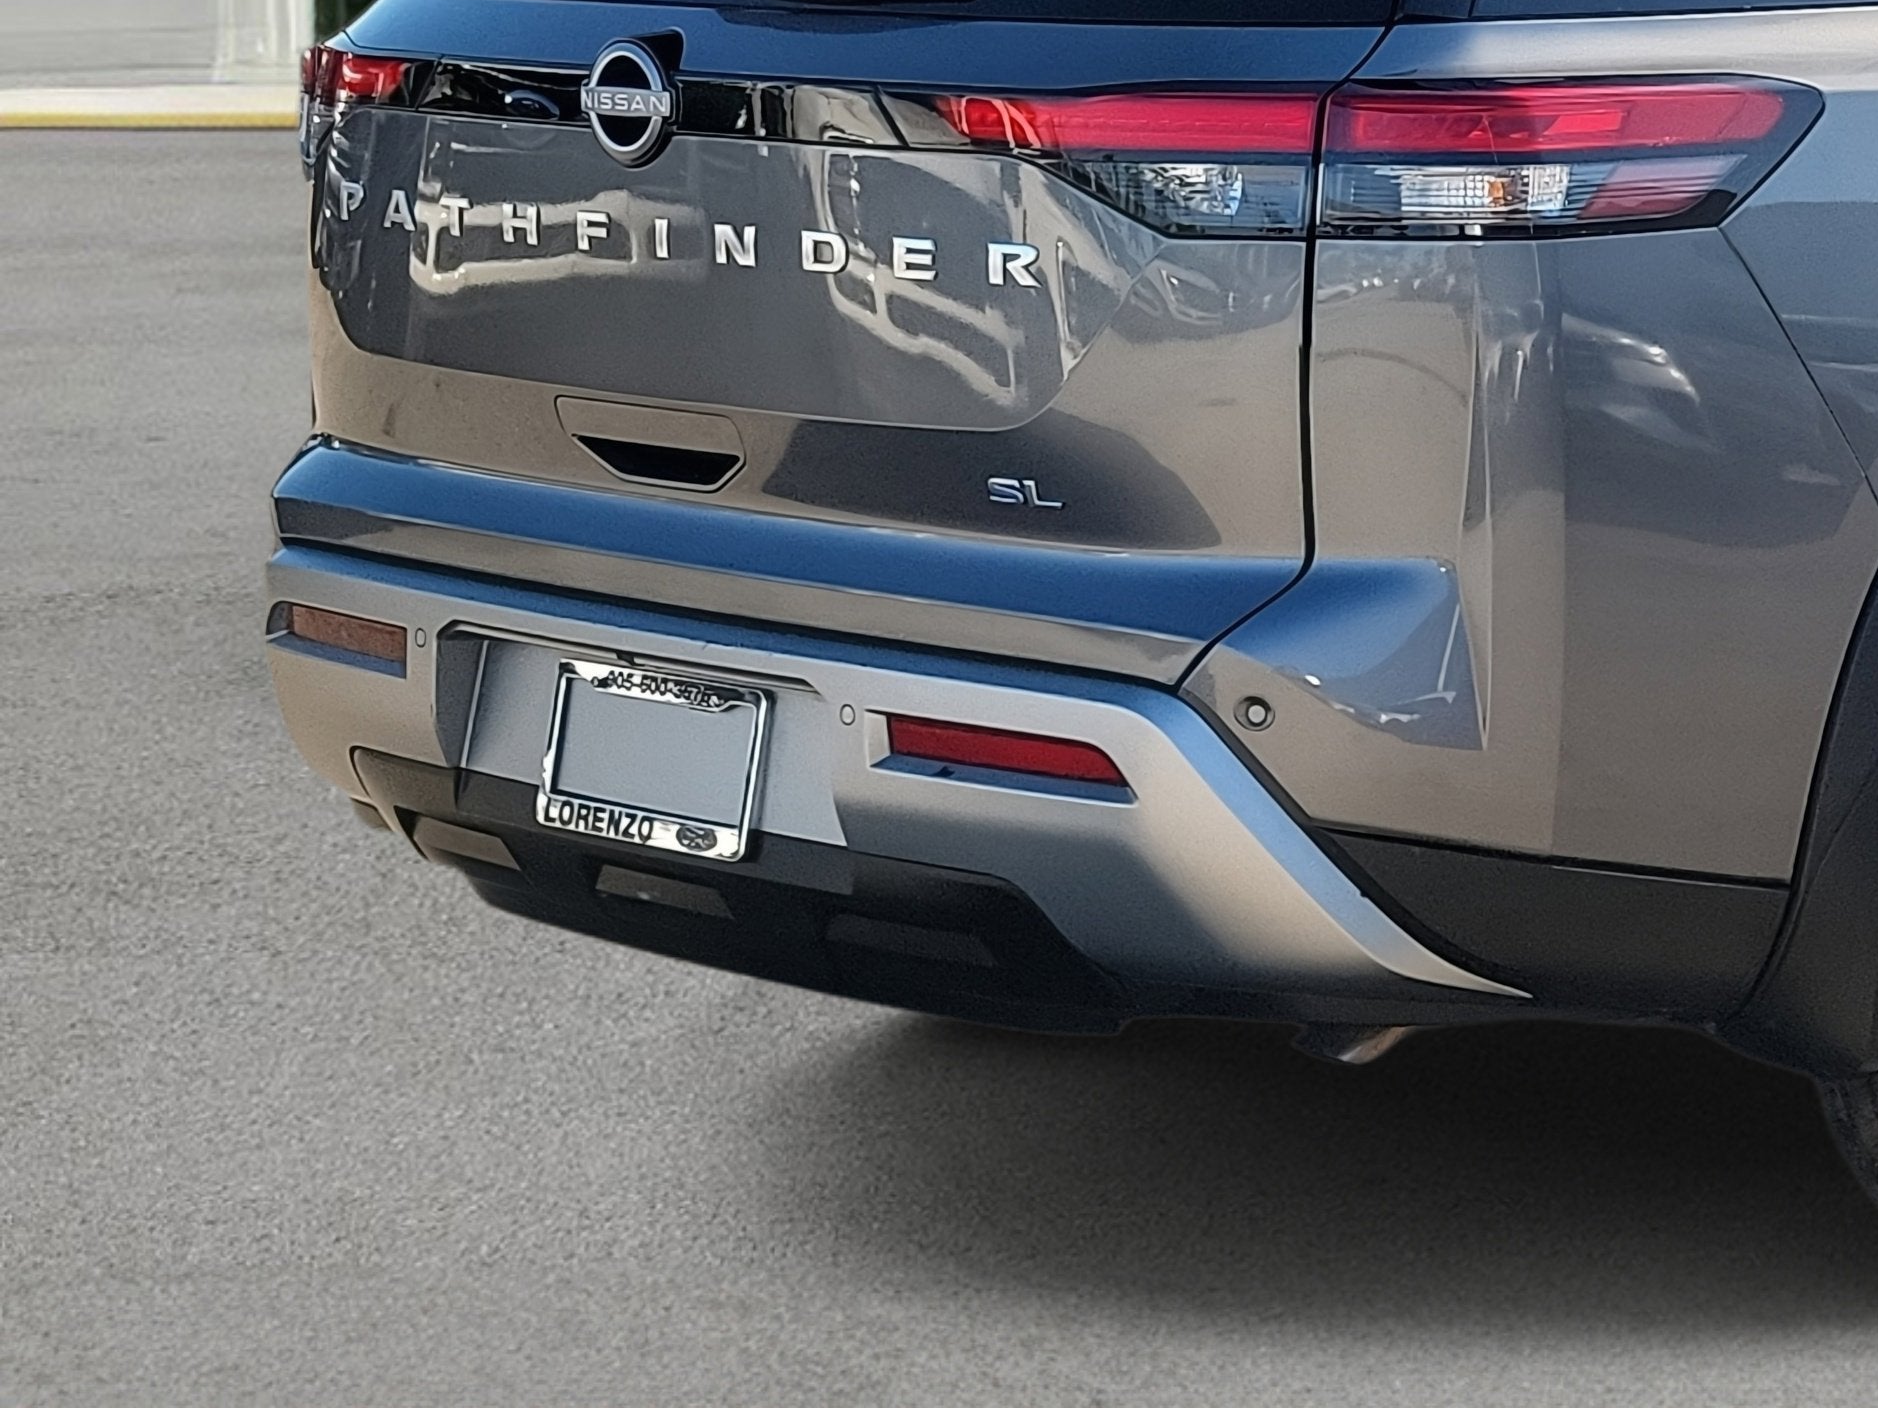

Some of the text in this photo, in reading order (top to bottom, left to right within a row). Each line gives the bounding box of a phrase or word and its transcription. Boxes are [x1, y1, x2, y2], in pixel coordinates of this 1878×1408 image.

[581, 91, 666, 112] NISSAN
[339, 180, 1042, 288] PATHFINDER
[987, 477, 1063, 509] SL
[543, 799, 655, 844] LORENZO
